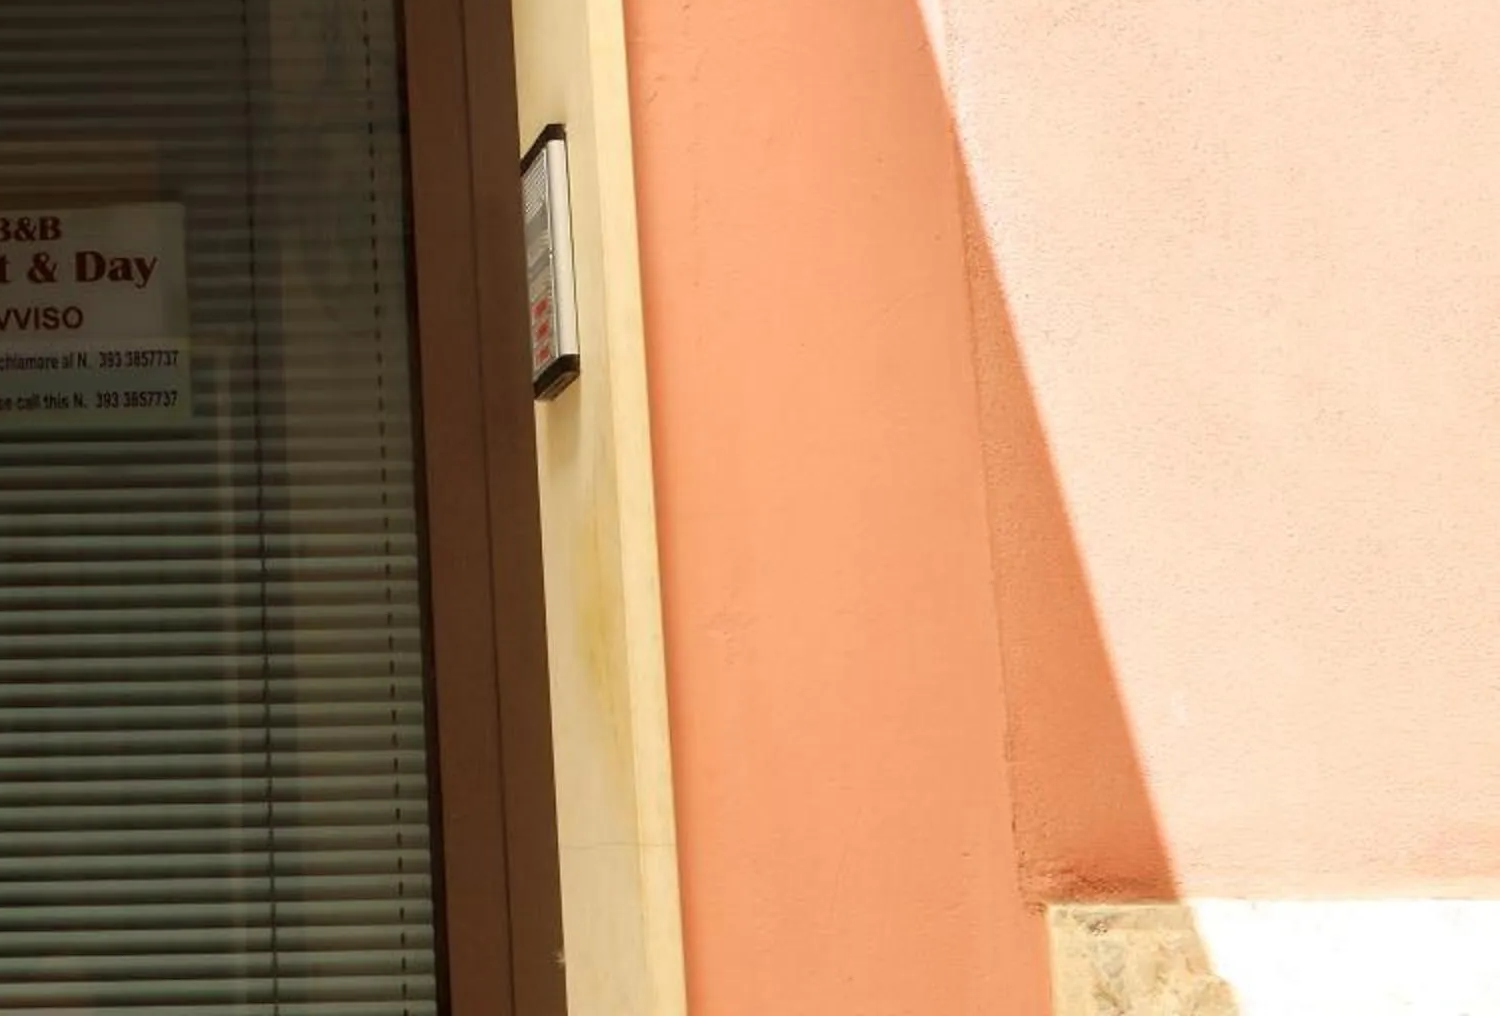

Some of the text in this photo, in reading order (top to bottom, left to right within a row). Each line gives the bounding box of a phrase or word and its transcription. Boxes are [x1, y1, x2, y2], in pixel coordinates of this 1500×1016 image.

[27, 252, 58, 284] &
[75, 251, 158, 289] Day
[62, 351, 74, 369] al
[99, 350, 122, 369] 393
[125, 349, 179, 368] 3857737
[17, 391, 41, 411] call
[43, 391, 69, 410] this
[96, 390, 119, 409] 393
